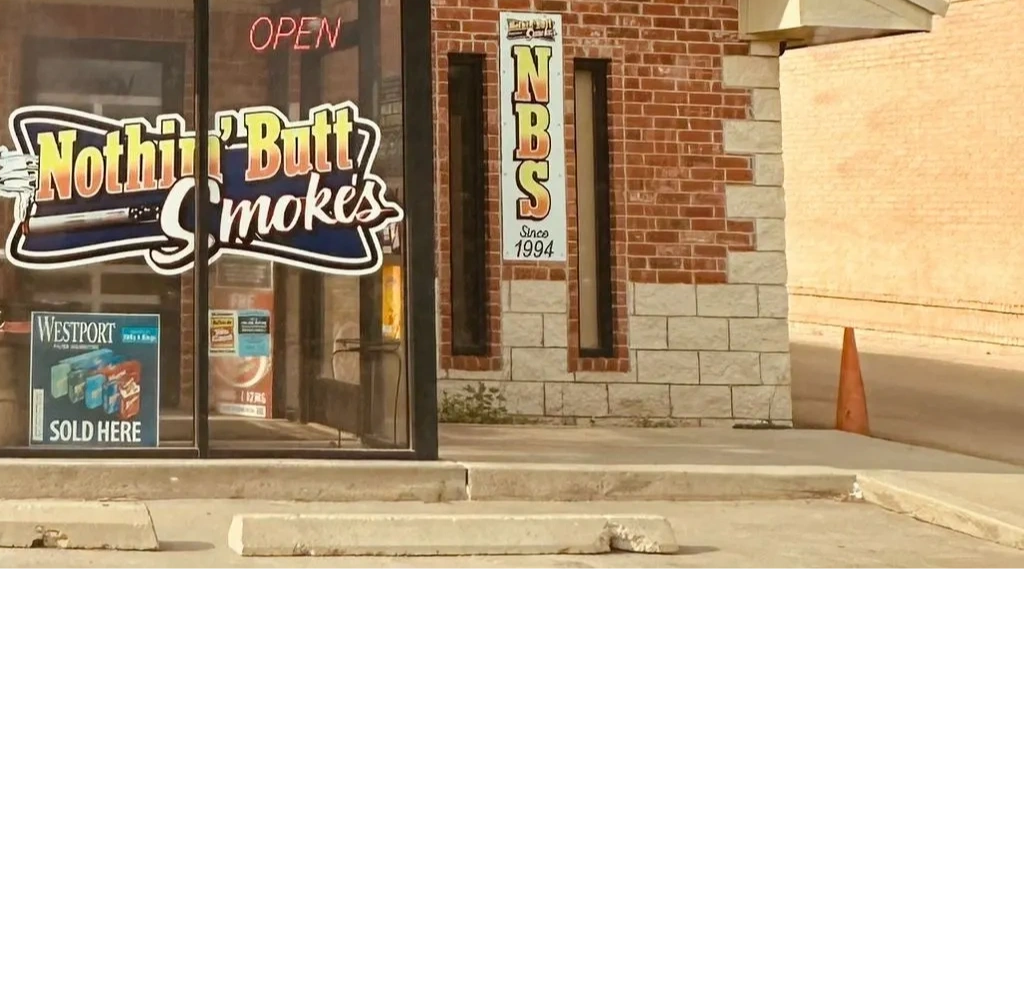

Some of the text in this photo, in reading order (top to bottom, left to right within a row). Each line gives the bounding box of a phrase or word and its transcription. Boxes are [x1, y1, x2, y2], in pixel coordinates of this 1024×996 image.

[249, 16, 342, 51] OPEN
[511, 45, 552, 220] NBS
[37, 115, 236, 201] Nothin'
[244, 107, 355, 182] Butt
[519, 224, 549, 239] Since
[514, 239, 554, 258] 1994
[37, 316, 117, 344] WESTPORT
[49, 420, 142, 442] SOLD HERE
